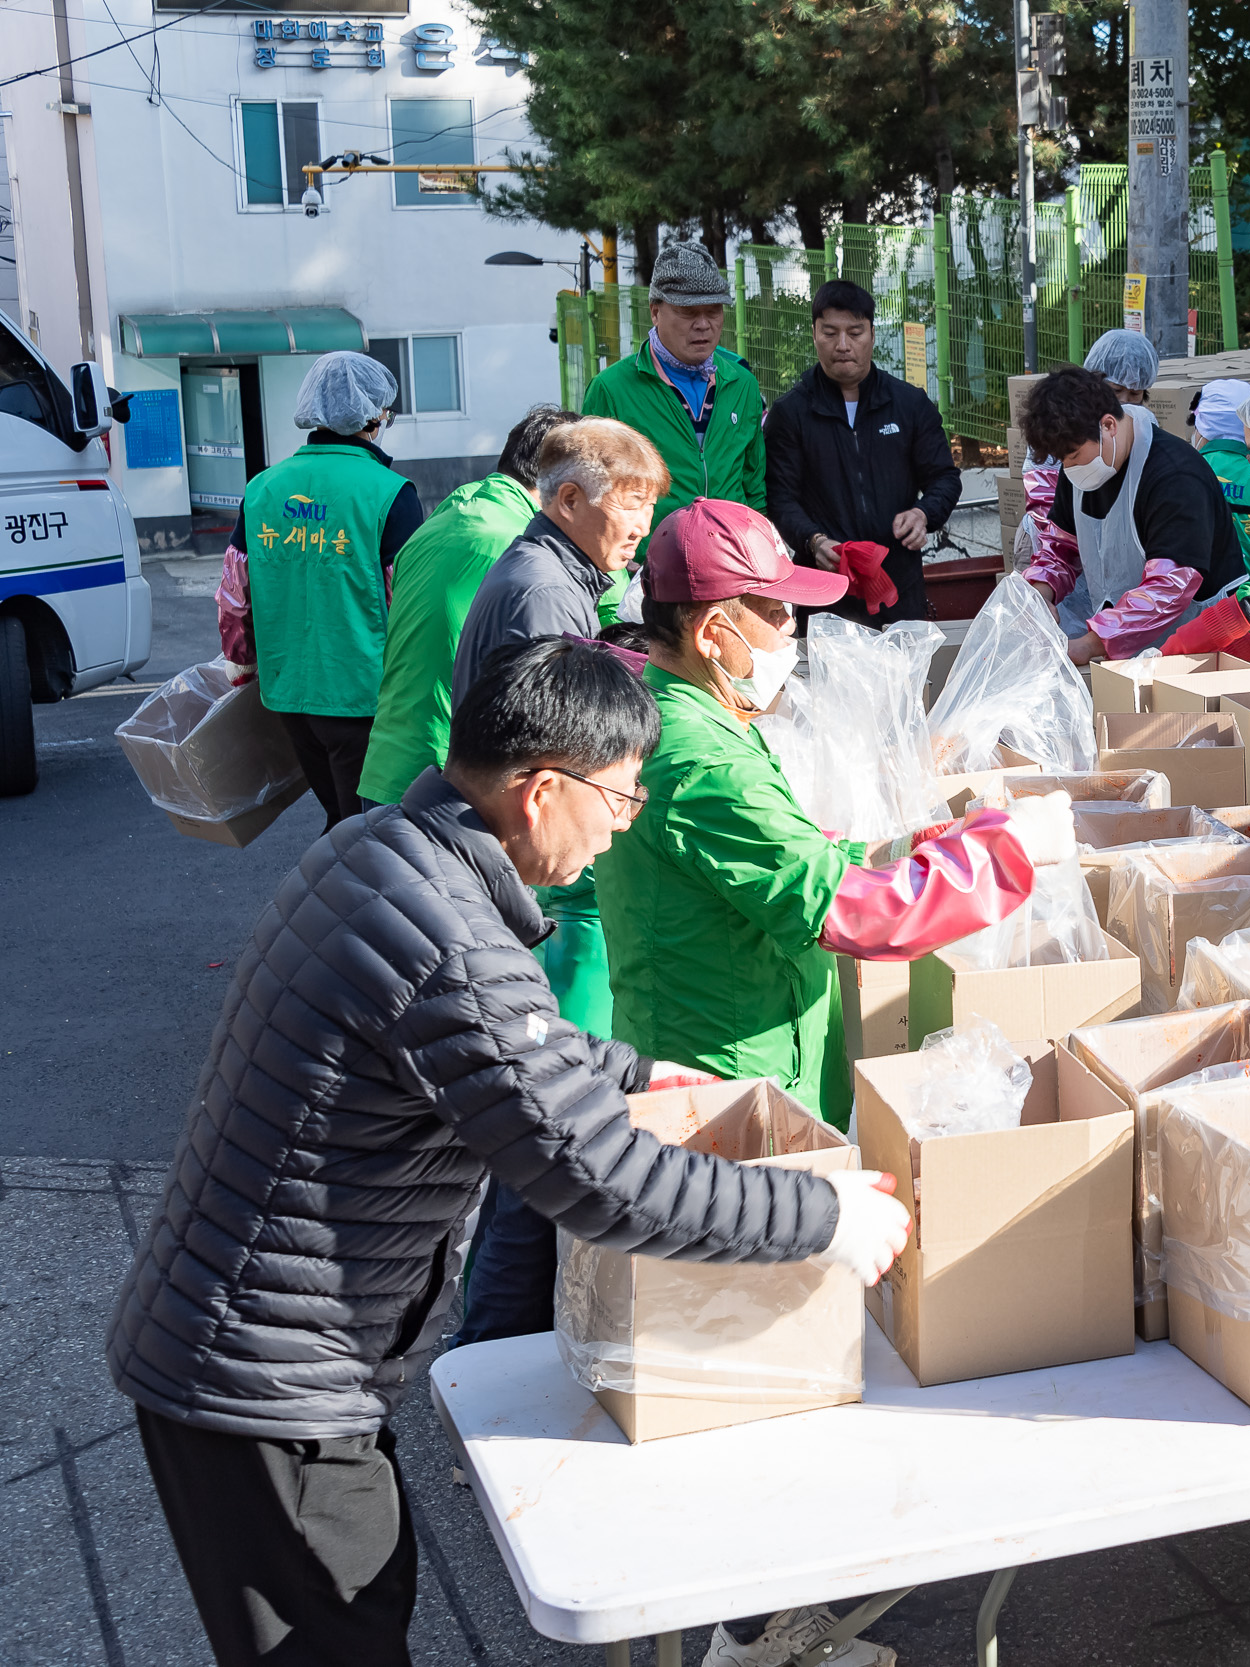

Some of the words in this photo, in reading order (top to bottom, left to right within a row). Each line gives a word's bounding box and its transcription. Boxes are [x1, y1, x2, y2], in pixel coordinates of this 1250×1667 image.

[254, 19, 385, 41] 대한예수교
[256, 48, 386, 69] 장로회
[283, 500, 327, 521] SMU
[5, 511, 69, 545] 광진구
